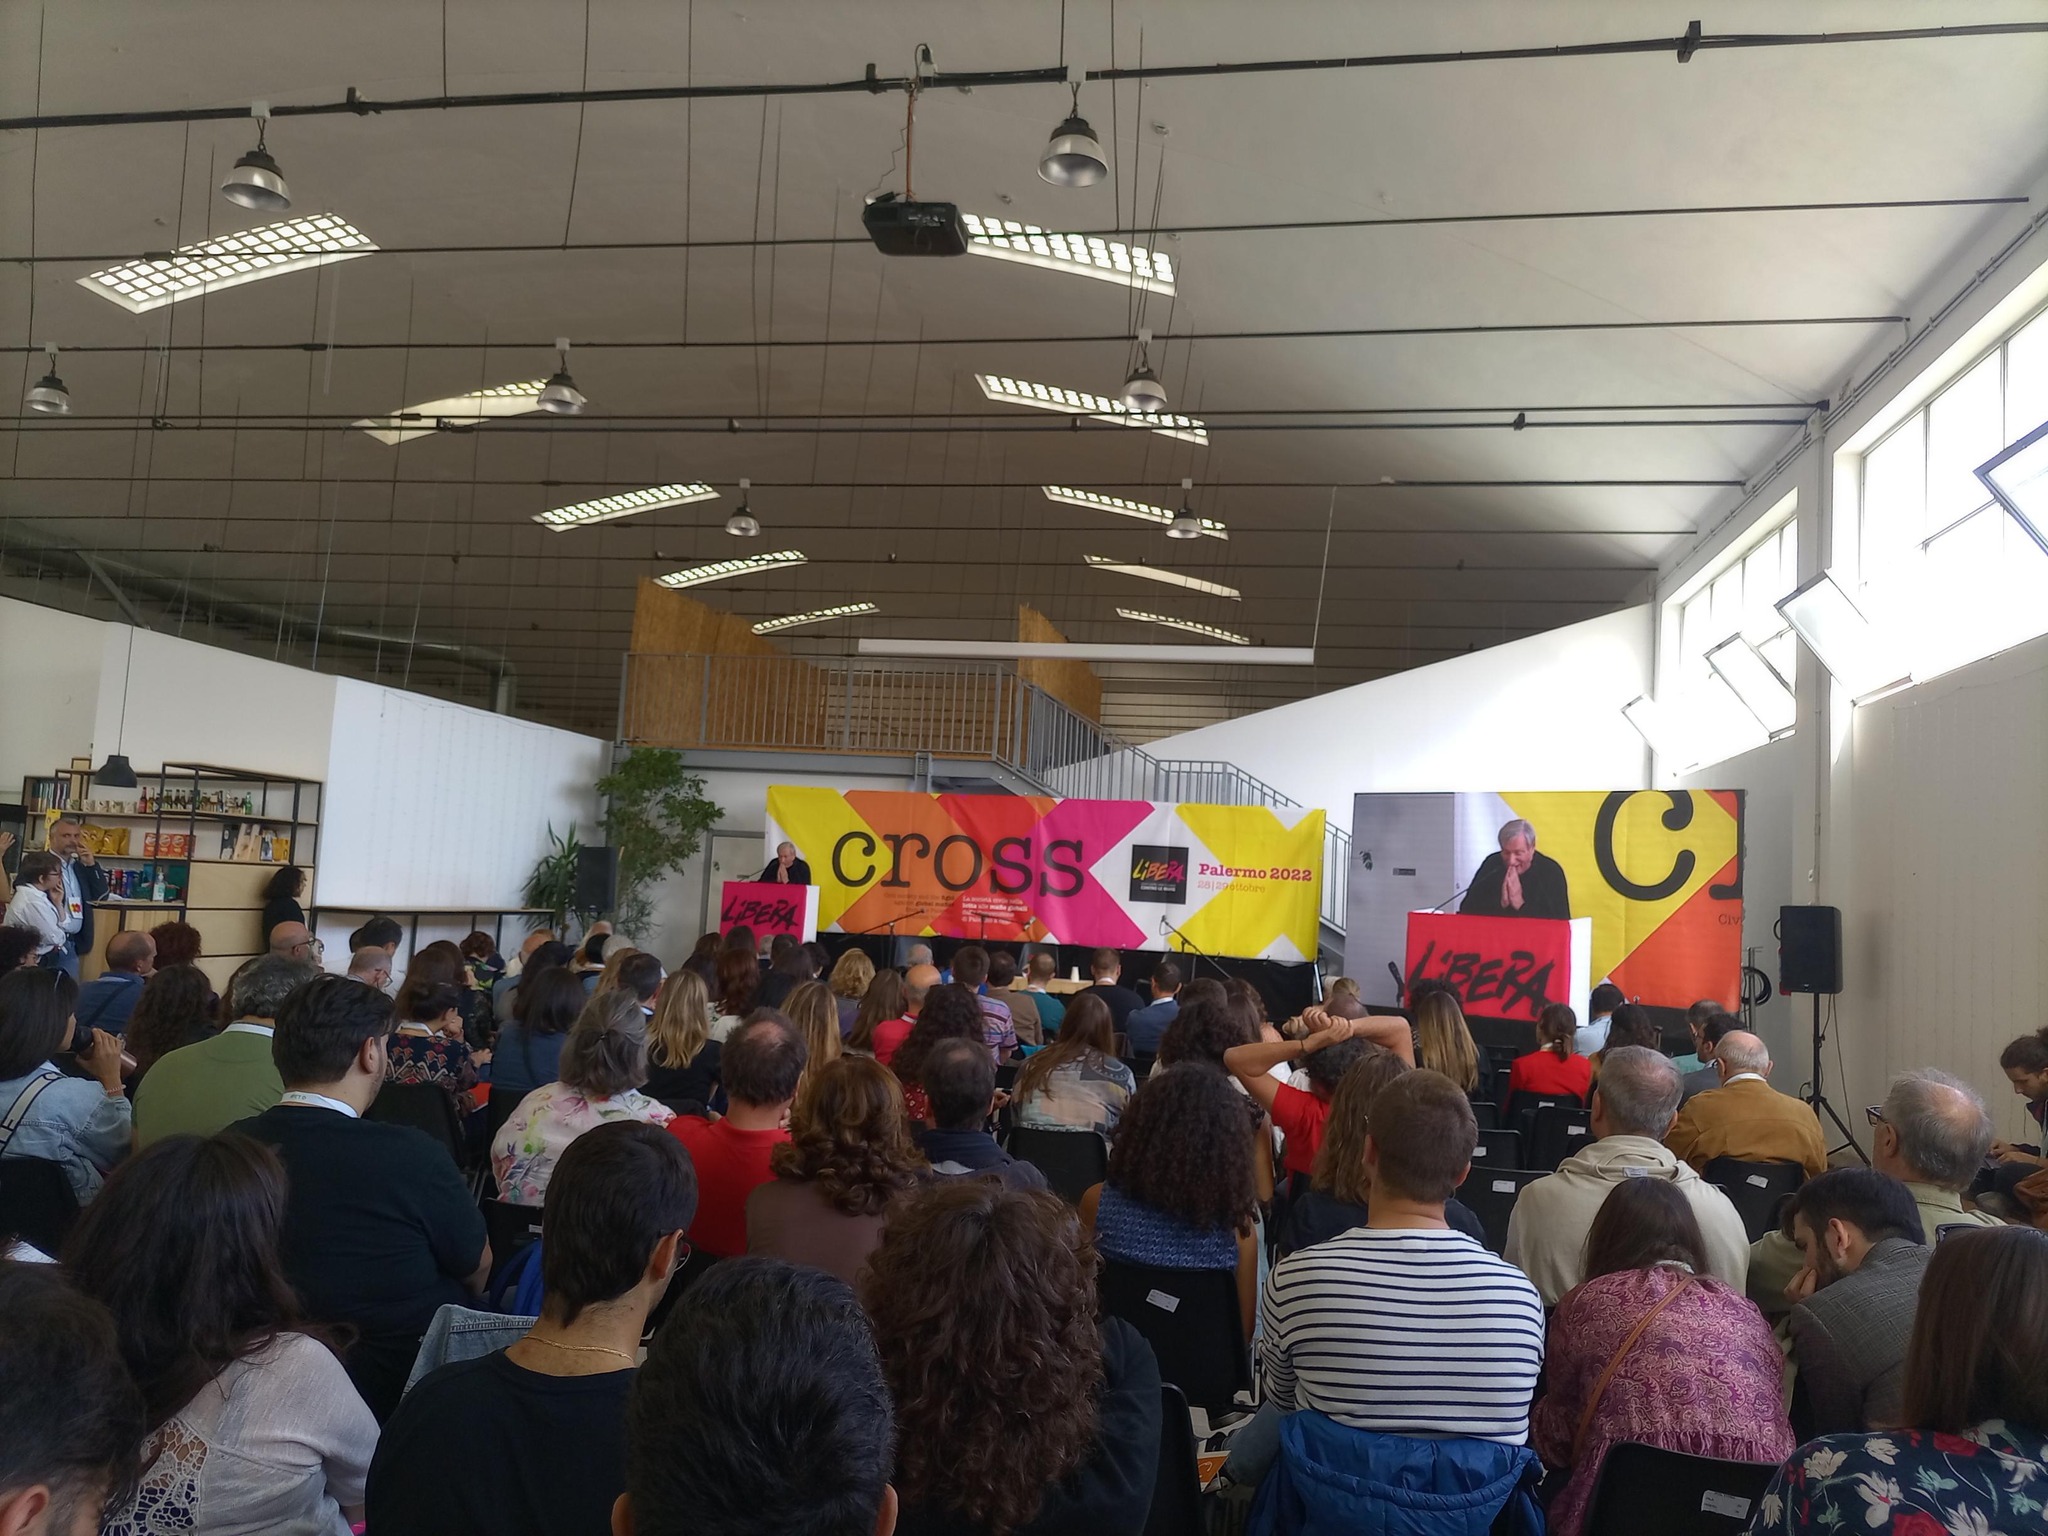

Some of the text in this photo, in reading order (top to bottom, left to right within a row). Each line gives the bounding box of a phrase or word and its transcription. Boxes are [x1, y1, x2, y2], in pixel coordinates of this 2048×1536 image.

[832, 831, 1084, 898] cross
[1198, 863, 1312, 882] Palermo 2022
[1229, 882, 1266, 894] ottobre
